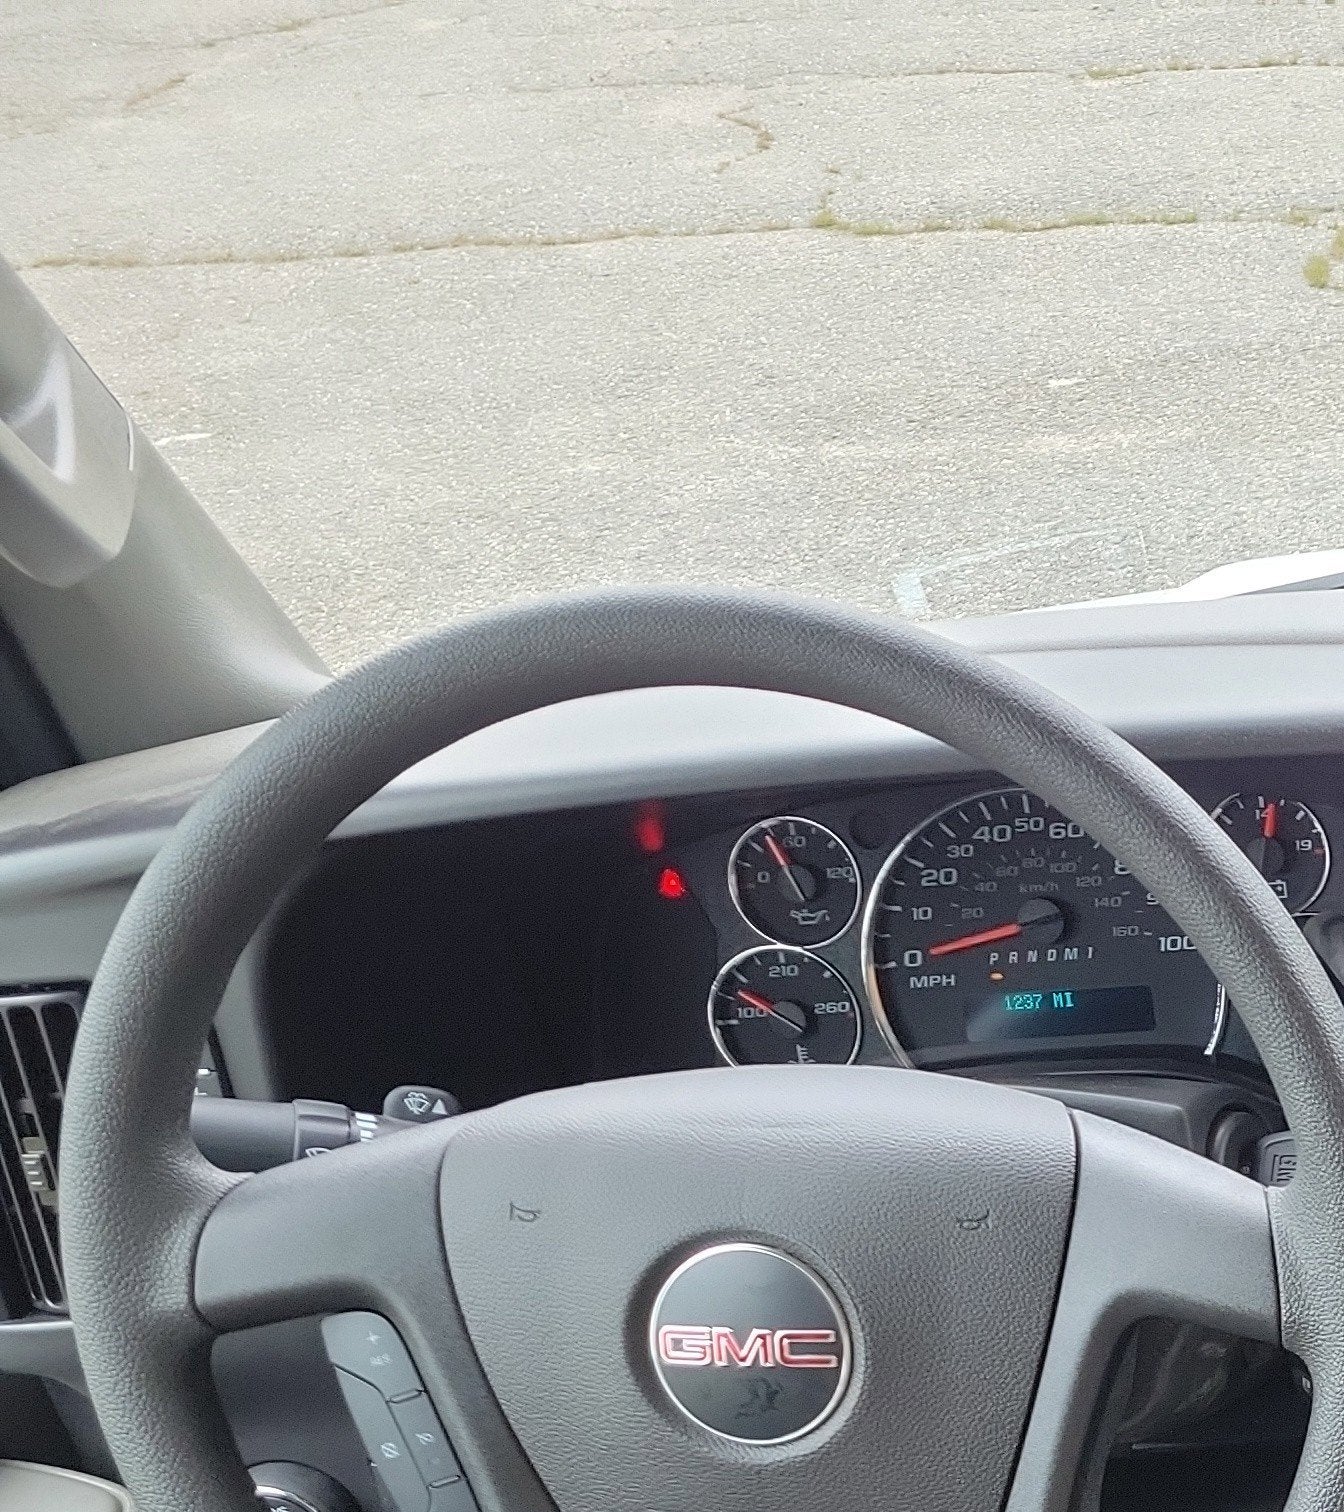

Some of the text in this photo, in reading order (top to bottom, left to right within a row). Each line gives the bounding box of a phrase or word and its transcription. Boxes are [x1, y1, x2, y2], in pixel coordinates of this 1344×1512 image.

[1014, 817, 1044, 832] 50
[1049, 822, 1085, 839] 60
[971, 825, 1013, 843] 40
[783, 836, 806, 848] 60
[1295, 839, 1312, 851] 19
[946, 844, 974, 858] 30
[757, 872, 770, 883] 0
[826, 867, 853, 880] 120
[921, 868, 958, 886] 20
[912, 907, 932, 920] 10
[961, 908, 984, 919] 20
[904, 950, 923, 967] 0
[769, 965, 799, 977] 210
[909, 974, 956, 989] MPH
[1005, 992, 1075, 1010] 1237 MI
[737, 1007, 768, 1019] 100
[814, 1002, 850, 1014] 260
[658, 1324, 839, 1369] GMC
